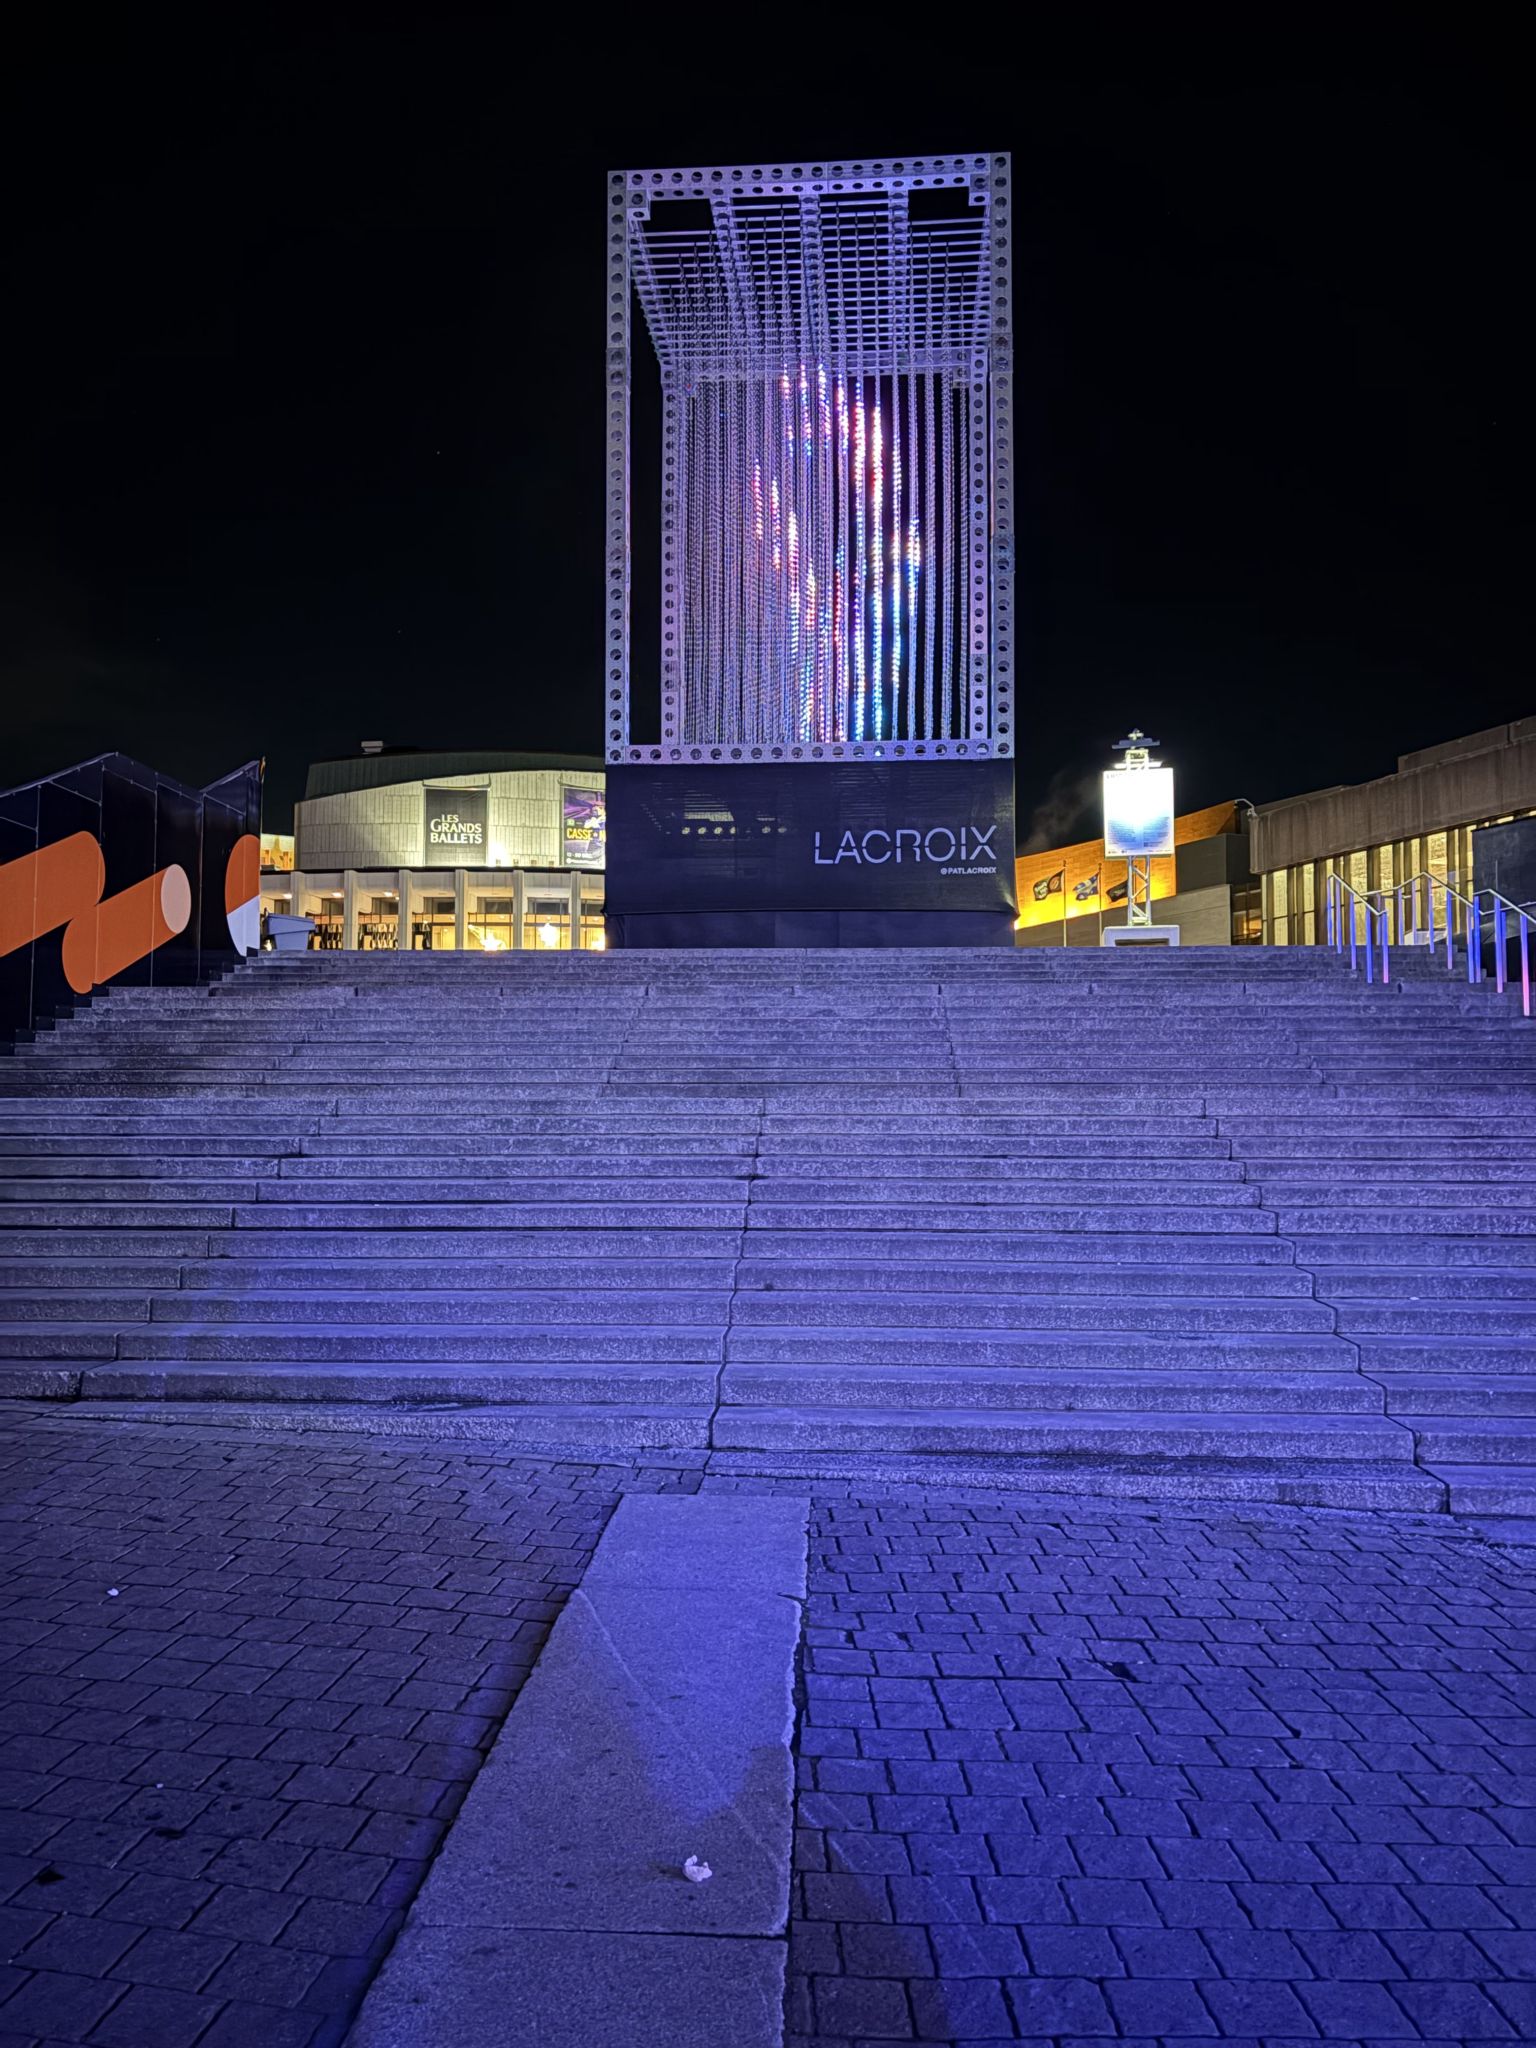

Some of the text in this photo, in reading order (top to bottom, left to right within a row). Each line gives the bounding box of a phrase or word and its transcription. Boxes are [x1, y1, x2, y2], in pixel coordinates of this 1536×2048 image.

[441, 814, 459, 823] LES
[430, 818, 482, 833] GRANDS
[430, 832, 483, 844] BALLETS
[814, 825, 997, 864] LACROIX
[940, 866, 997, 875] @PATLACROIX
